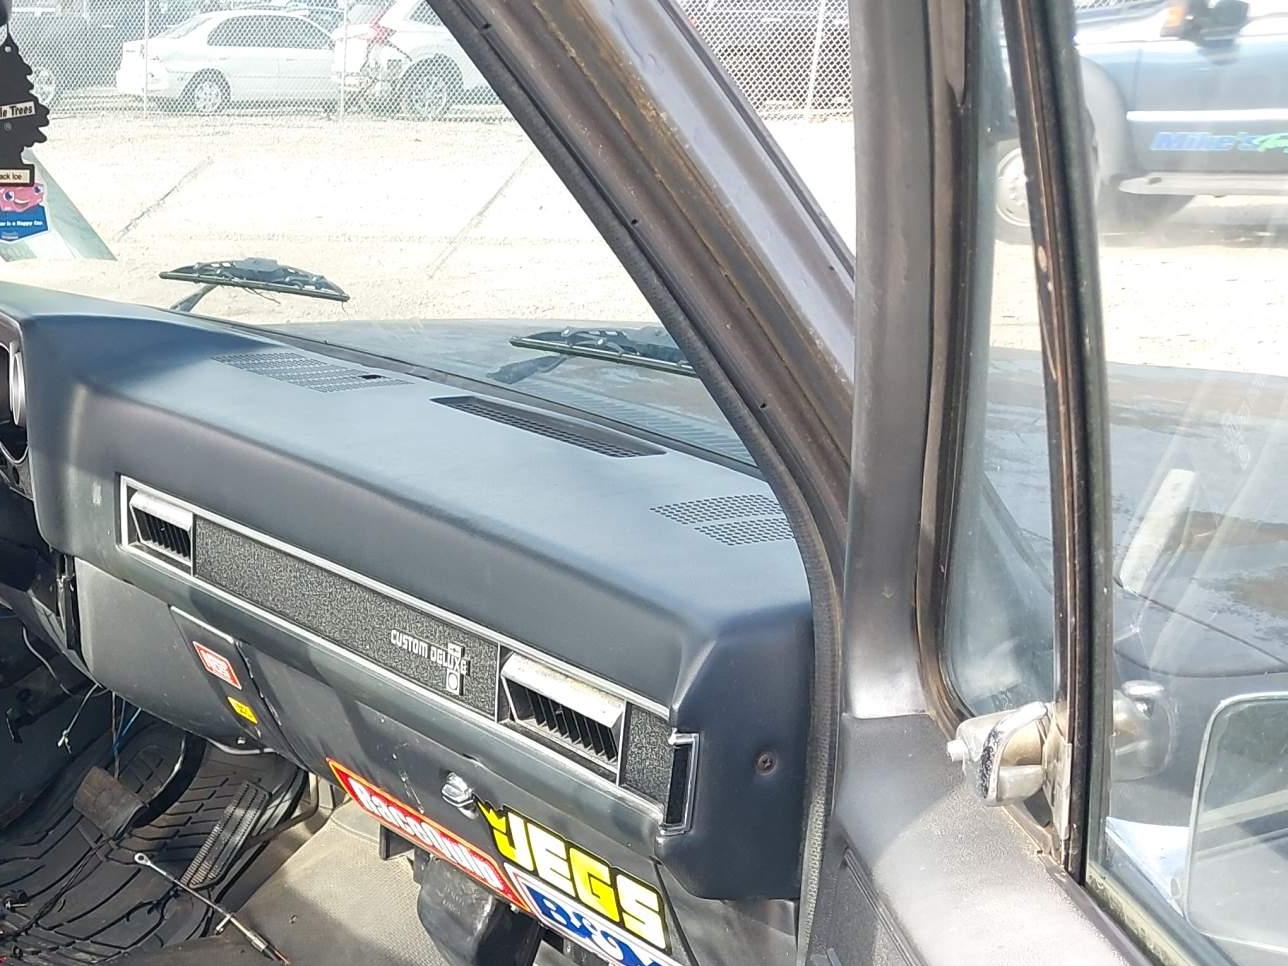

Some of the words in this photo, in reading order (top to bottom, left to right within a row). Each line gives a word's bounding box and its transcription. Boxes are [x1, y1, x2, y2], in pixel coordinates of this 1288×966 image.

[9, 105, 33, 116] Trees
[391, 629, 428, 659] CUSTOM
[480, 802, 667, 950] JEGS
